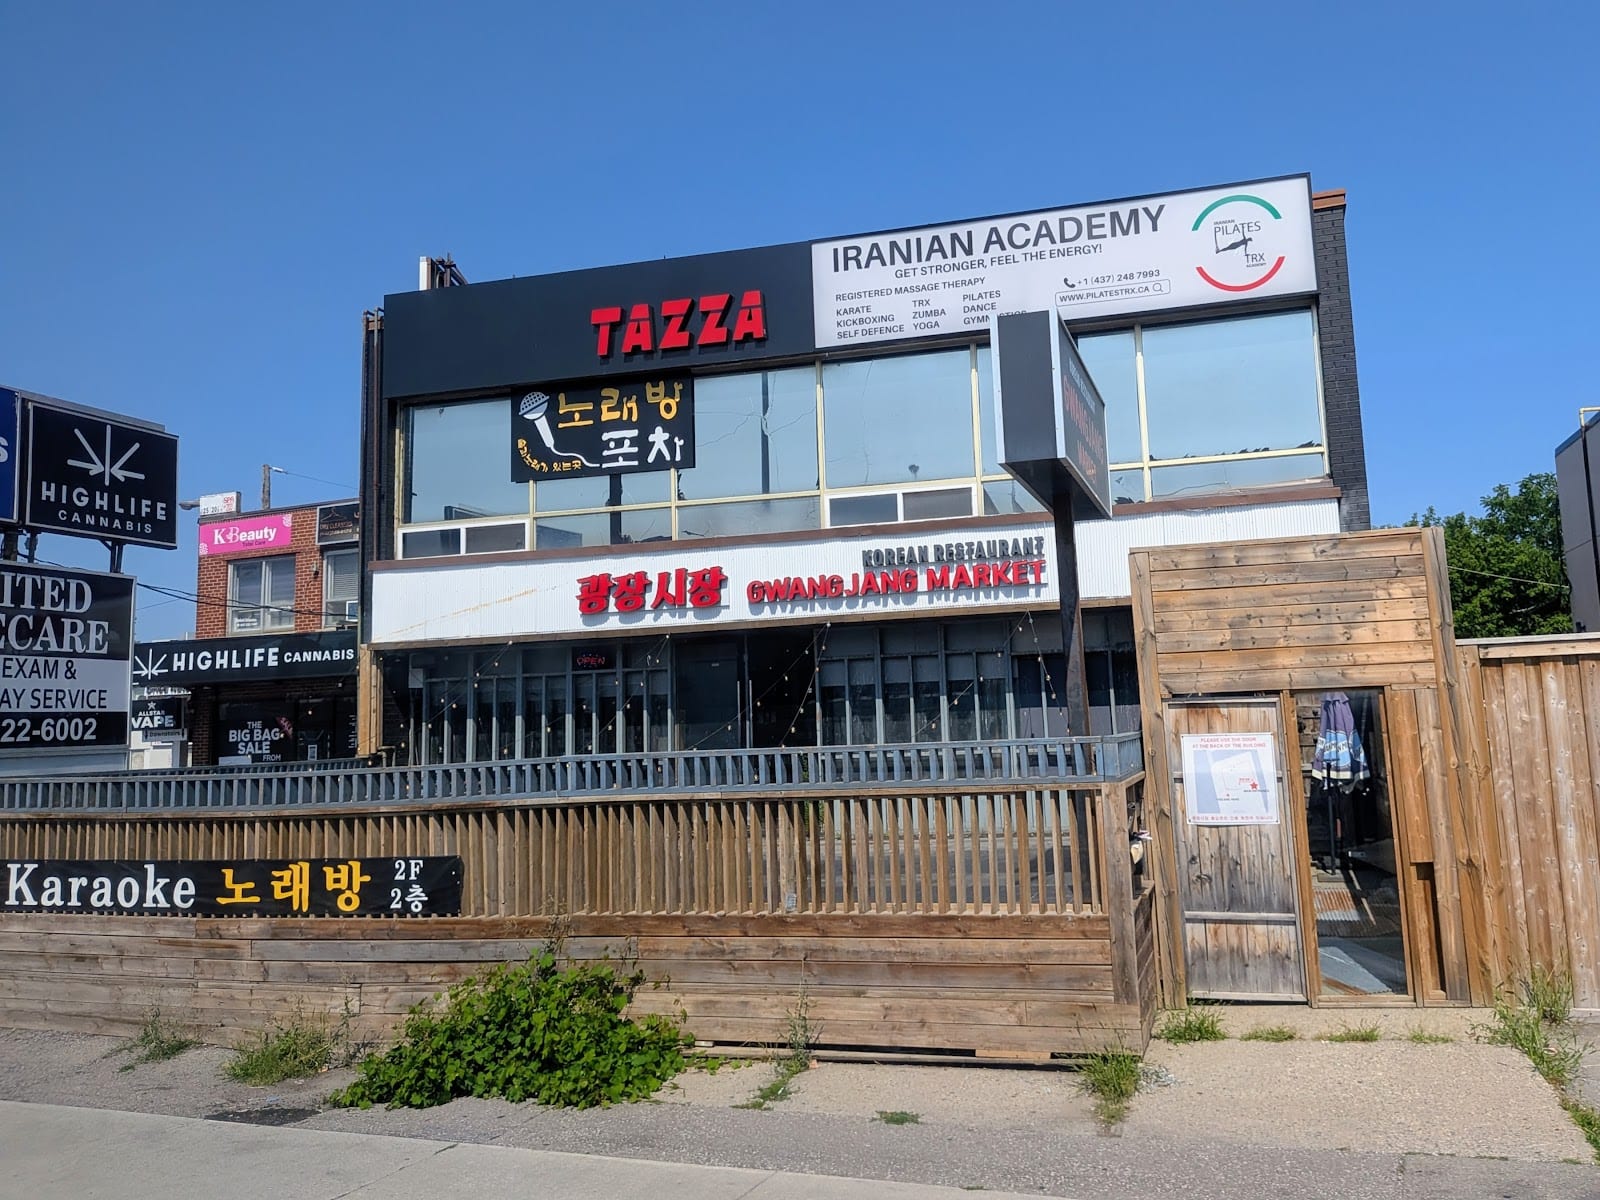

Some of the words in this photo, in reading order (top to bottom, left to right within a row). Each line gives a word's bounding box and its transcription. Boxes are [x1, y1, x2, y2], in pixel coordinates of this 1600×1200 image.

[833, 230, 974, 273] IRANIAN
[983, 204, 1165, 254] ACADEMY
[1214, 221, 1261, 235] PILATES
[894, 267, 918, 280] GET
[920, 258, 988, 277] STRONGER,
[990, 254, 1020, 267] FEEL
[1022, 250, 1046, 262] THE
[1049, 244, 1103, 259] ENERGY!
[1245, 253, 1265, 263] TRX
[1091, 274, 1115, 285] (437)
[1117, 272, 1135, 282] 248
[1136, 269, 1160, 279] 7993
[835, 288, 893, 302] REGISTERED
[894, 283, 940, 296] MASSAGE
[942, 276, 986, 290] THERAPY
[962, 290, 1001, 302] PILATES
[1059, 286, 1150, 302] WWW.PILATESTRX.CA
[836, 305, 872, 316] KARATE
[912, 299, 930, 308] TRX
[912, 308, 946, 320] ZUMBA
[963, 302, 997, 314] DANCE
[590, 289, 766, 357] TAZZA
[836, 314, 895, 328] KICKBOXING
[837, 328, 860, 339] SELF
[861, 324, 905, 337] DEFENCE
[913, 321, 940, 331] YOGA
[558, 380, 683, 429] 노래방
[601, 426, 684, 468] 포차
[41, 481, 167, 520] HIGHLIFE
[58, 509, 152, 534] CANNABIS
[862, 545, 929, 567] KOREAN
[934, 536, 1045, 562] RESTAURANT
[576, 565, 728, 615] 광장시장
[747, 567, 918, 604] GWANGJANG
[926, 559, 1047, 591] MARKET
[2, 658, 59, 679] EXAM
[64, 659, 77, 680] &
[172, 647, 280, 672] HIGHLIFE
[284, 648, 354, 664] CANNABIS
[30, 688, 108, 709] SERVICE
[131, 715, 174, 729] VAPE
[247, 721, 262, 729] THE
[228, 729, 250, 742] BIG
[253, 728, 280, 741] BAG
[238, 741, 270, 755] SALE
[394, 859, 424, 880] 2F
[5, 863, 196, 908] Karaoke
[216, 861, 371, 912] 노래방
[390, 884, 428, 912] 2층
